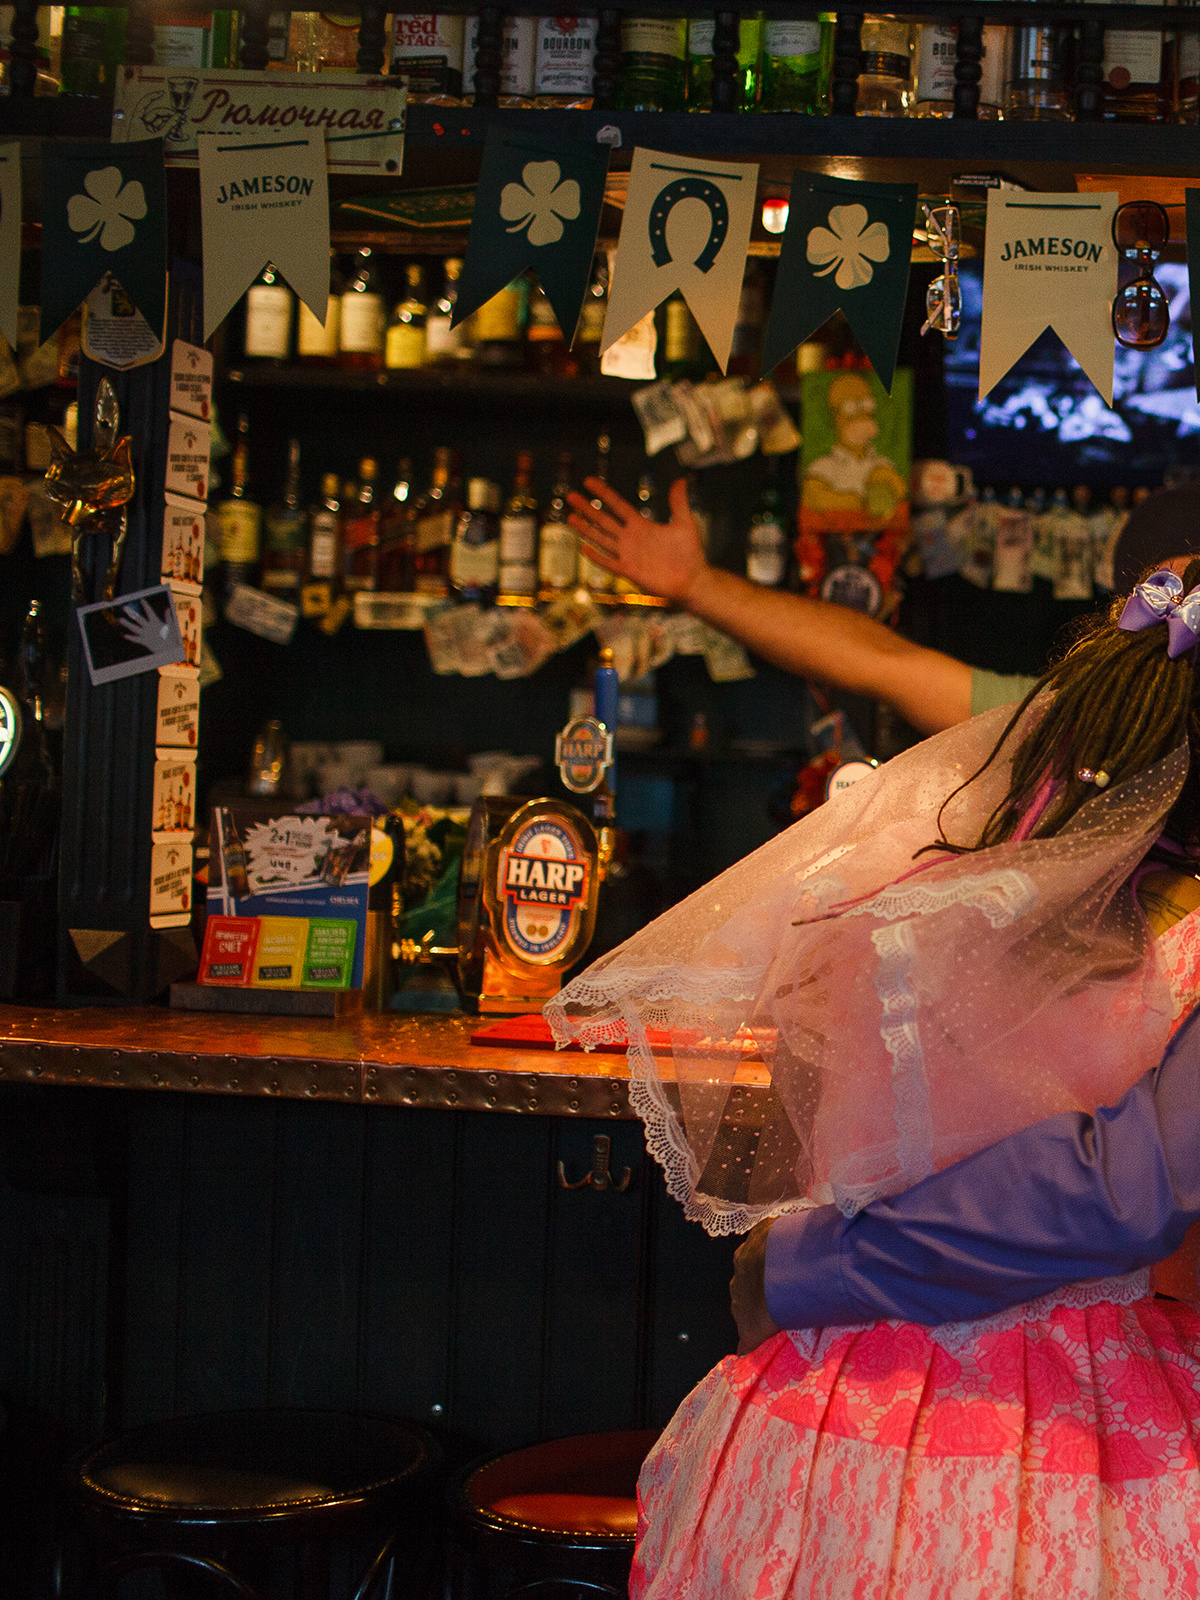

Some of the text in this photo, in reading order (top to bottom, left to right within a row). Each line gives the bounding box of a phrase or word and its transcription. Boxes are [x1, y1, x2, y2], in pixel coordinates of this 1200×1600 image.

[397, 14, 438, 34] red
[395, 33, 436, 47] STAG
[543, 37, 590, 51] BOURBON
[192, 87, 385, 131] Рюмочная
[217, 174, 315, 205] JAMESON
[231, 199, 303, 212] IRISH WHISKEY
[1001, 237, 1103, 263] JAMESON
[1015, 264, 1089, 273] IRISH WHISKEY
[506, 857, 584, 892] HARP
[520, 889, 568, 905] LAGER
